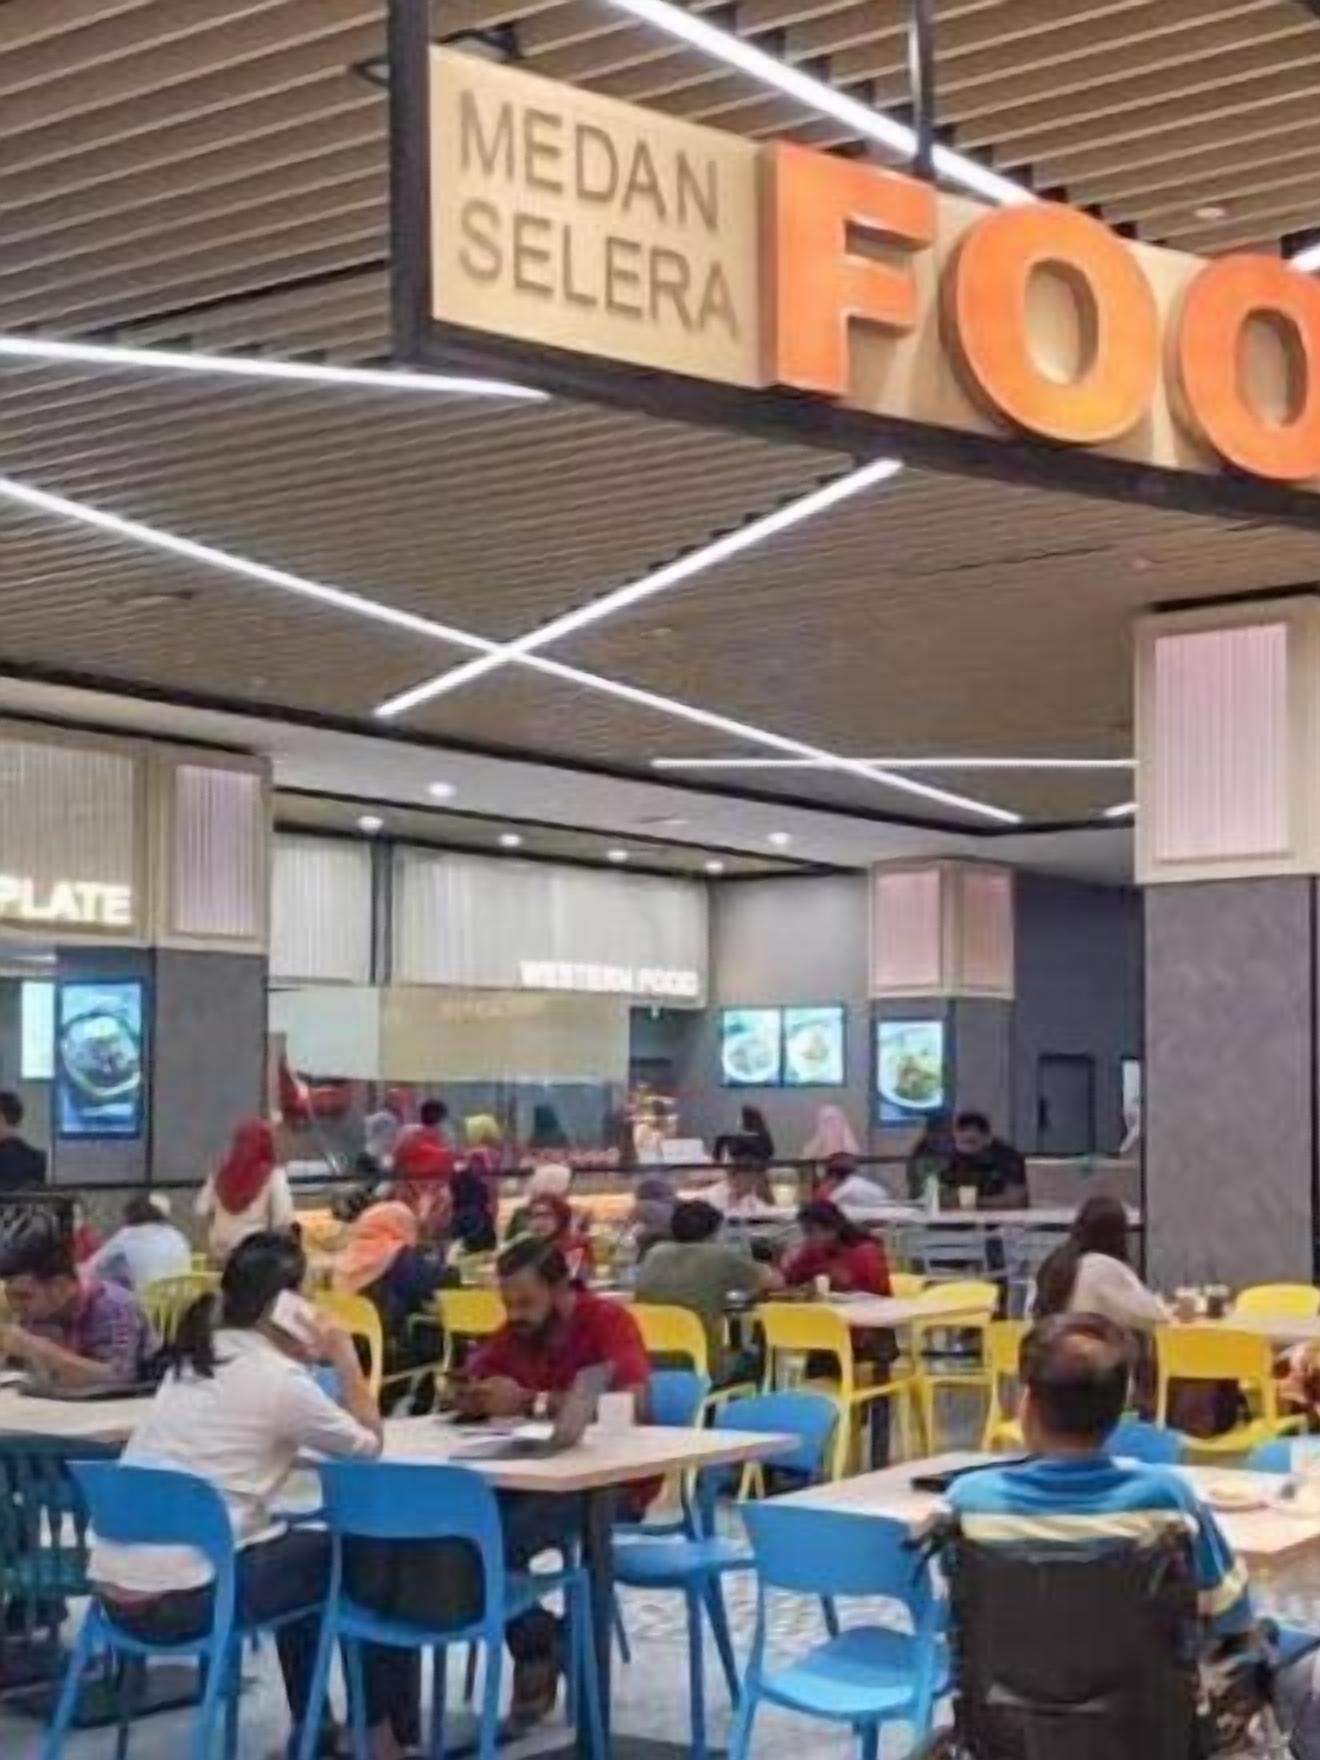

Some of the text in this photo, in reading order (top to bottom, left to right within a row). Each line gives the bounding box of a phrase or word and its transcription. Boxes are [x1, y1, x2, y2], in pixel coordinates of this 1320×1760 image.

[458, 88, 718, 234] MEDAN
[457, 197, 741, 342] SELERA
[638, 967, 699, 997] FOOD
